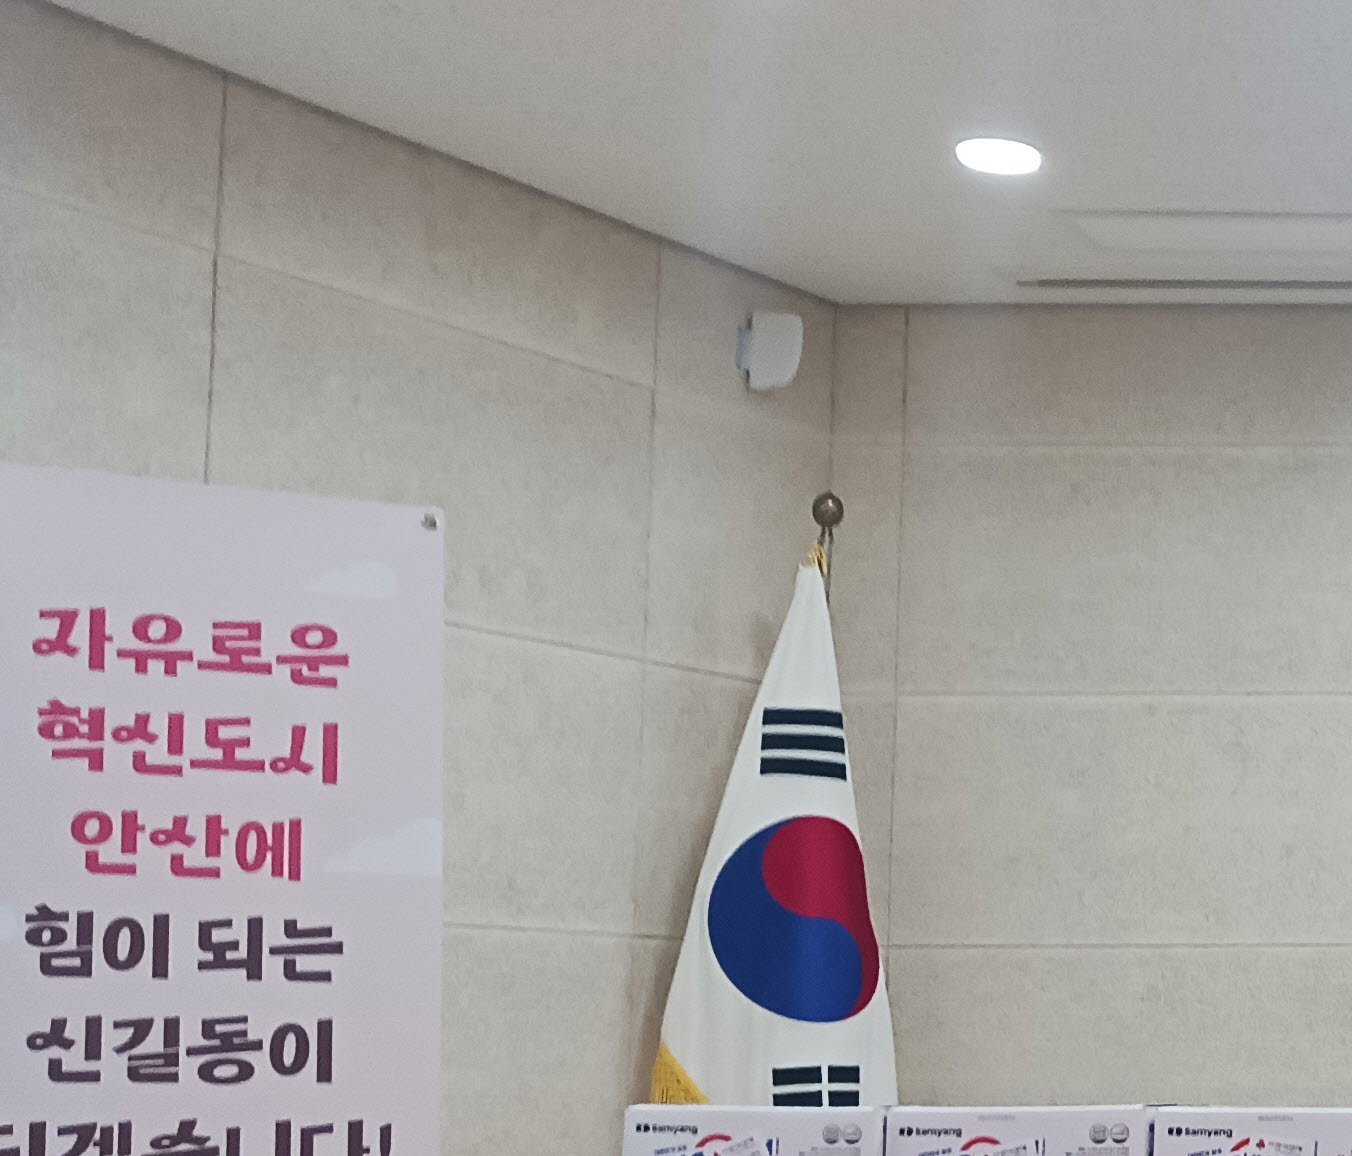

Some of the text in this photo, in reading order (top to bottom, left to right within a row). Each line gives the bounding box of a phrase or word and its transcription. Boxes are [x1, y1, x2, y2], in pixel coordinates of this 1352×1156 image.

[32, 606, 349, 689] 자유로운
[37, 697, 339, 785] 혁신도시
[70, 809, 302, 882] 안산에
[24, 904, 344, 983] 힘이 되는
[26, 1014, 333, 1085] 신길동이
